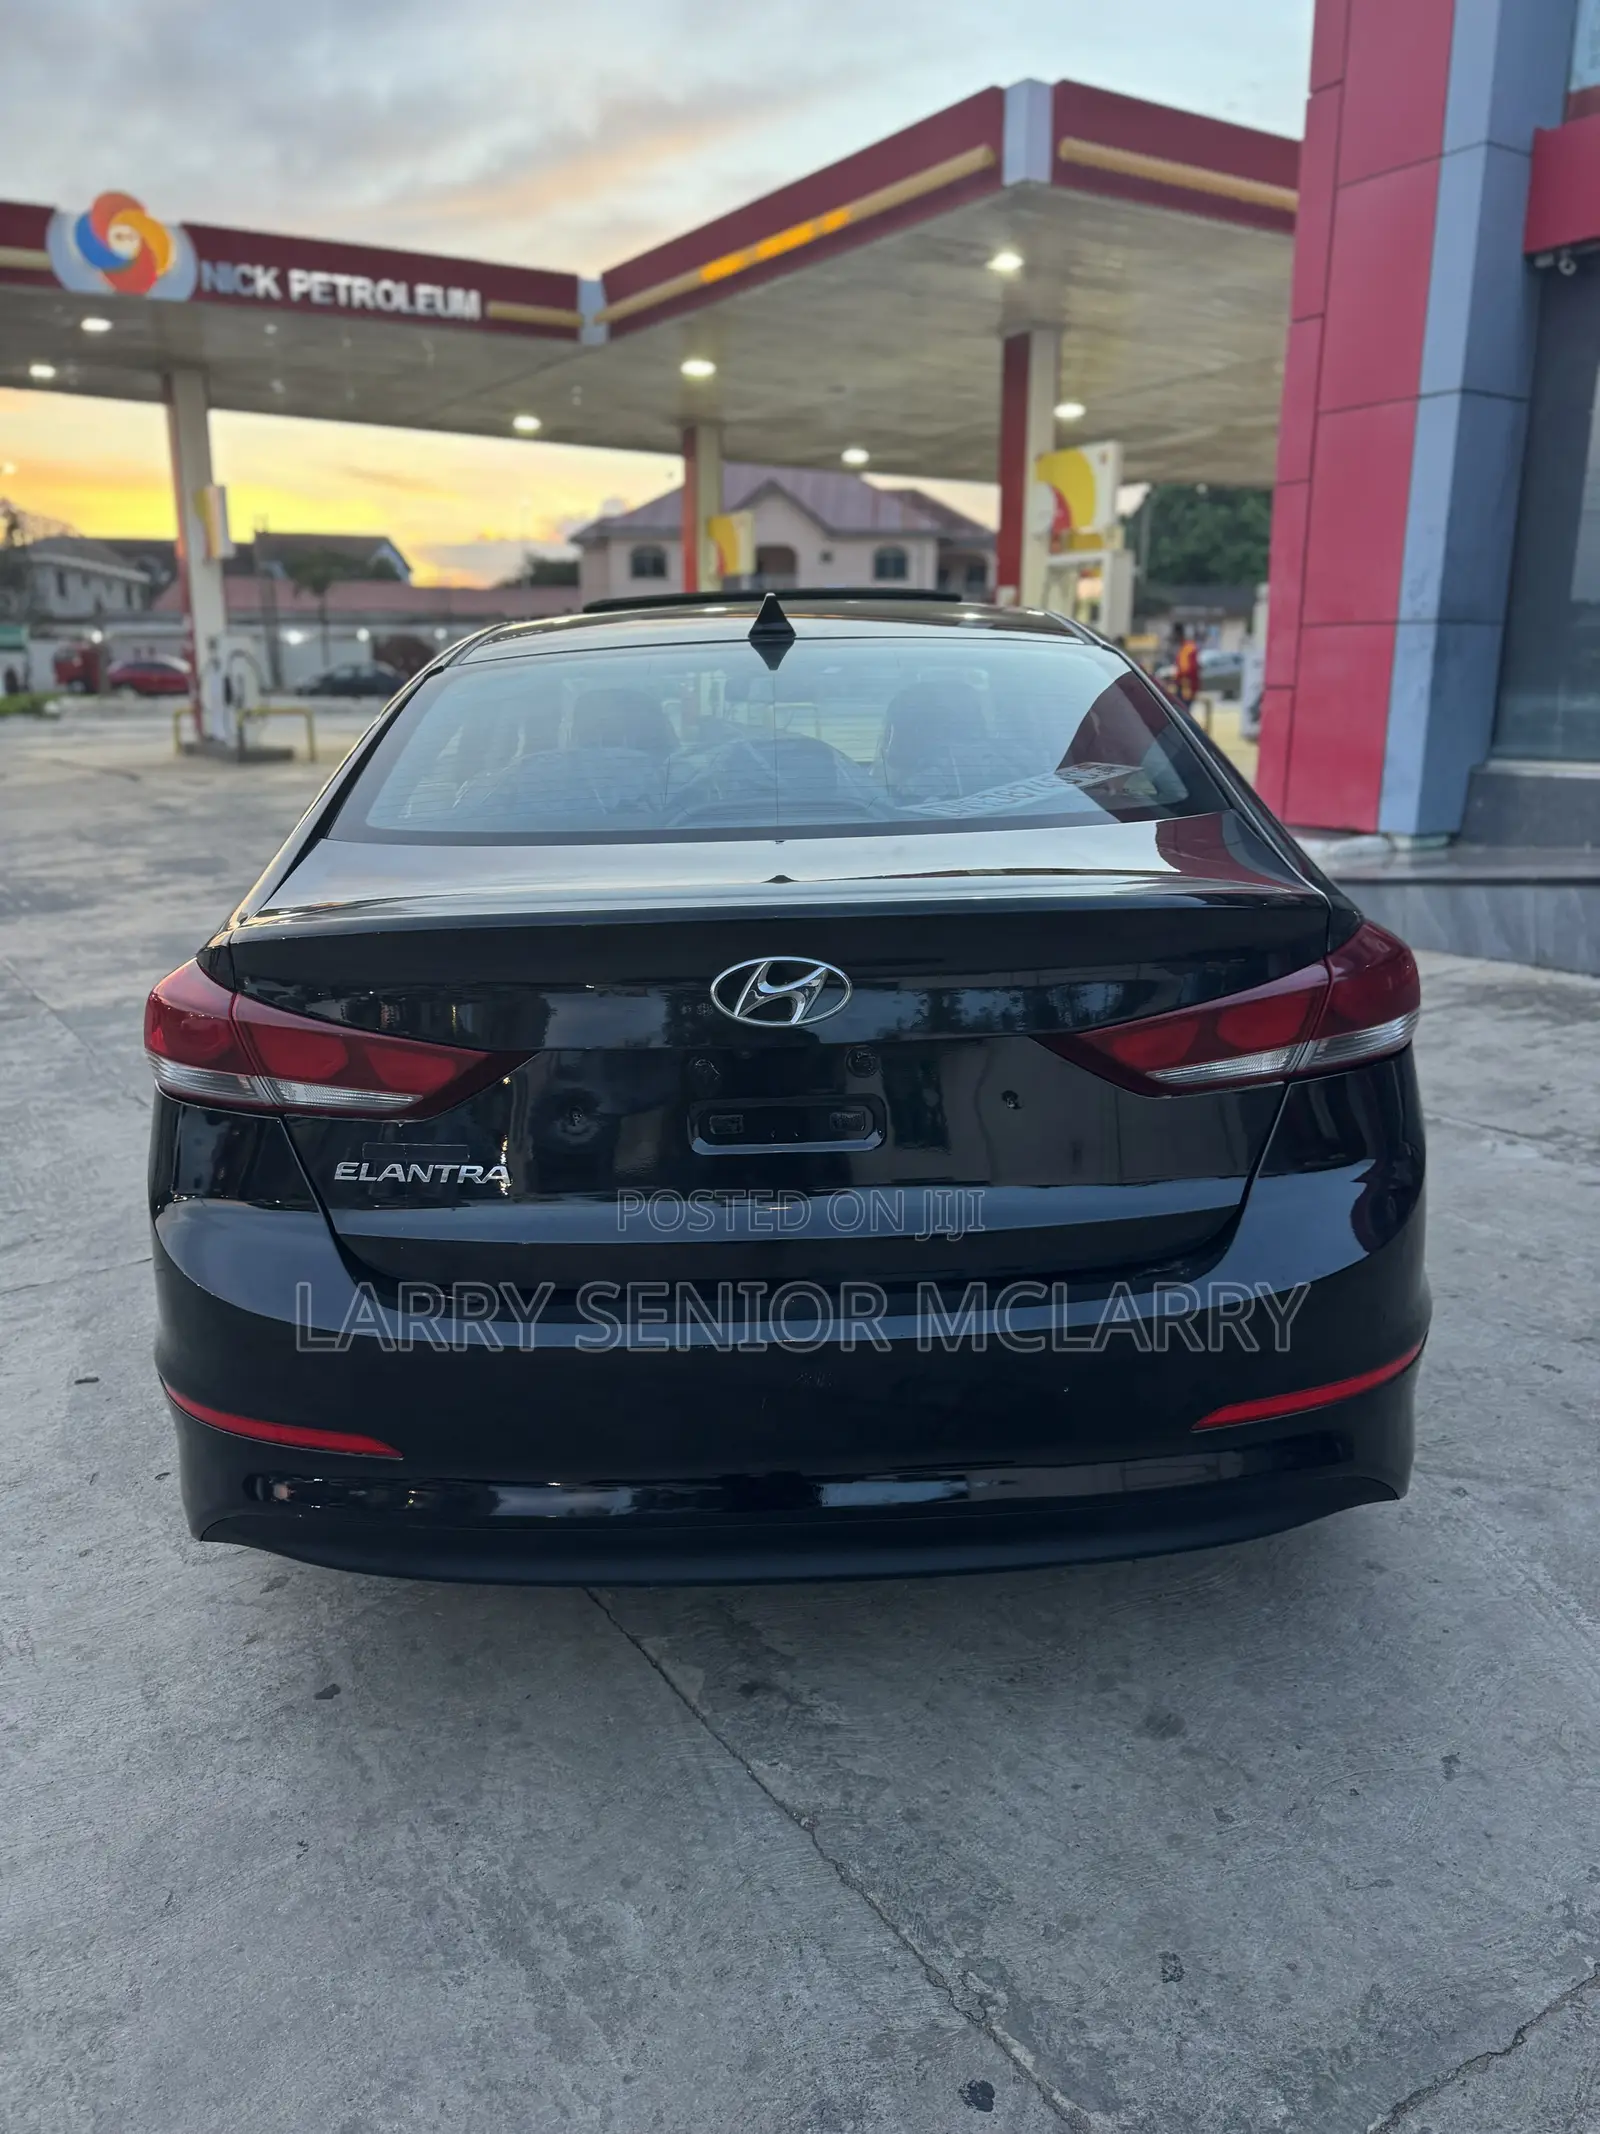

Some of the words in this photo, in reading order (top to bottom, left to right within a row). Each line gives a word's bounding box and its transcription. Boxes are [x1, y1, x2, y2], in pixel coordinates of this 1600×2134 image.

[200, 259, 282, 299] NICK
[287, 268, 481, 321] PETROLEUM
[334, 1161, 512, 1185] ELANTRA
